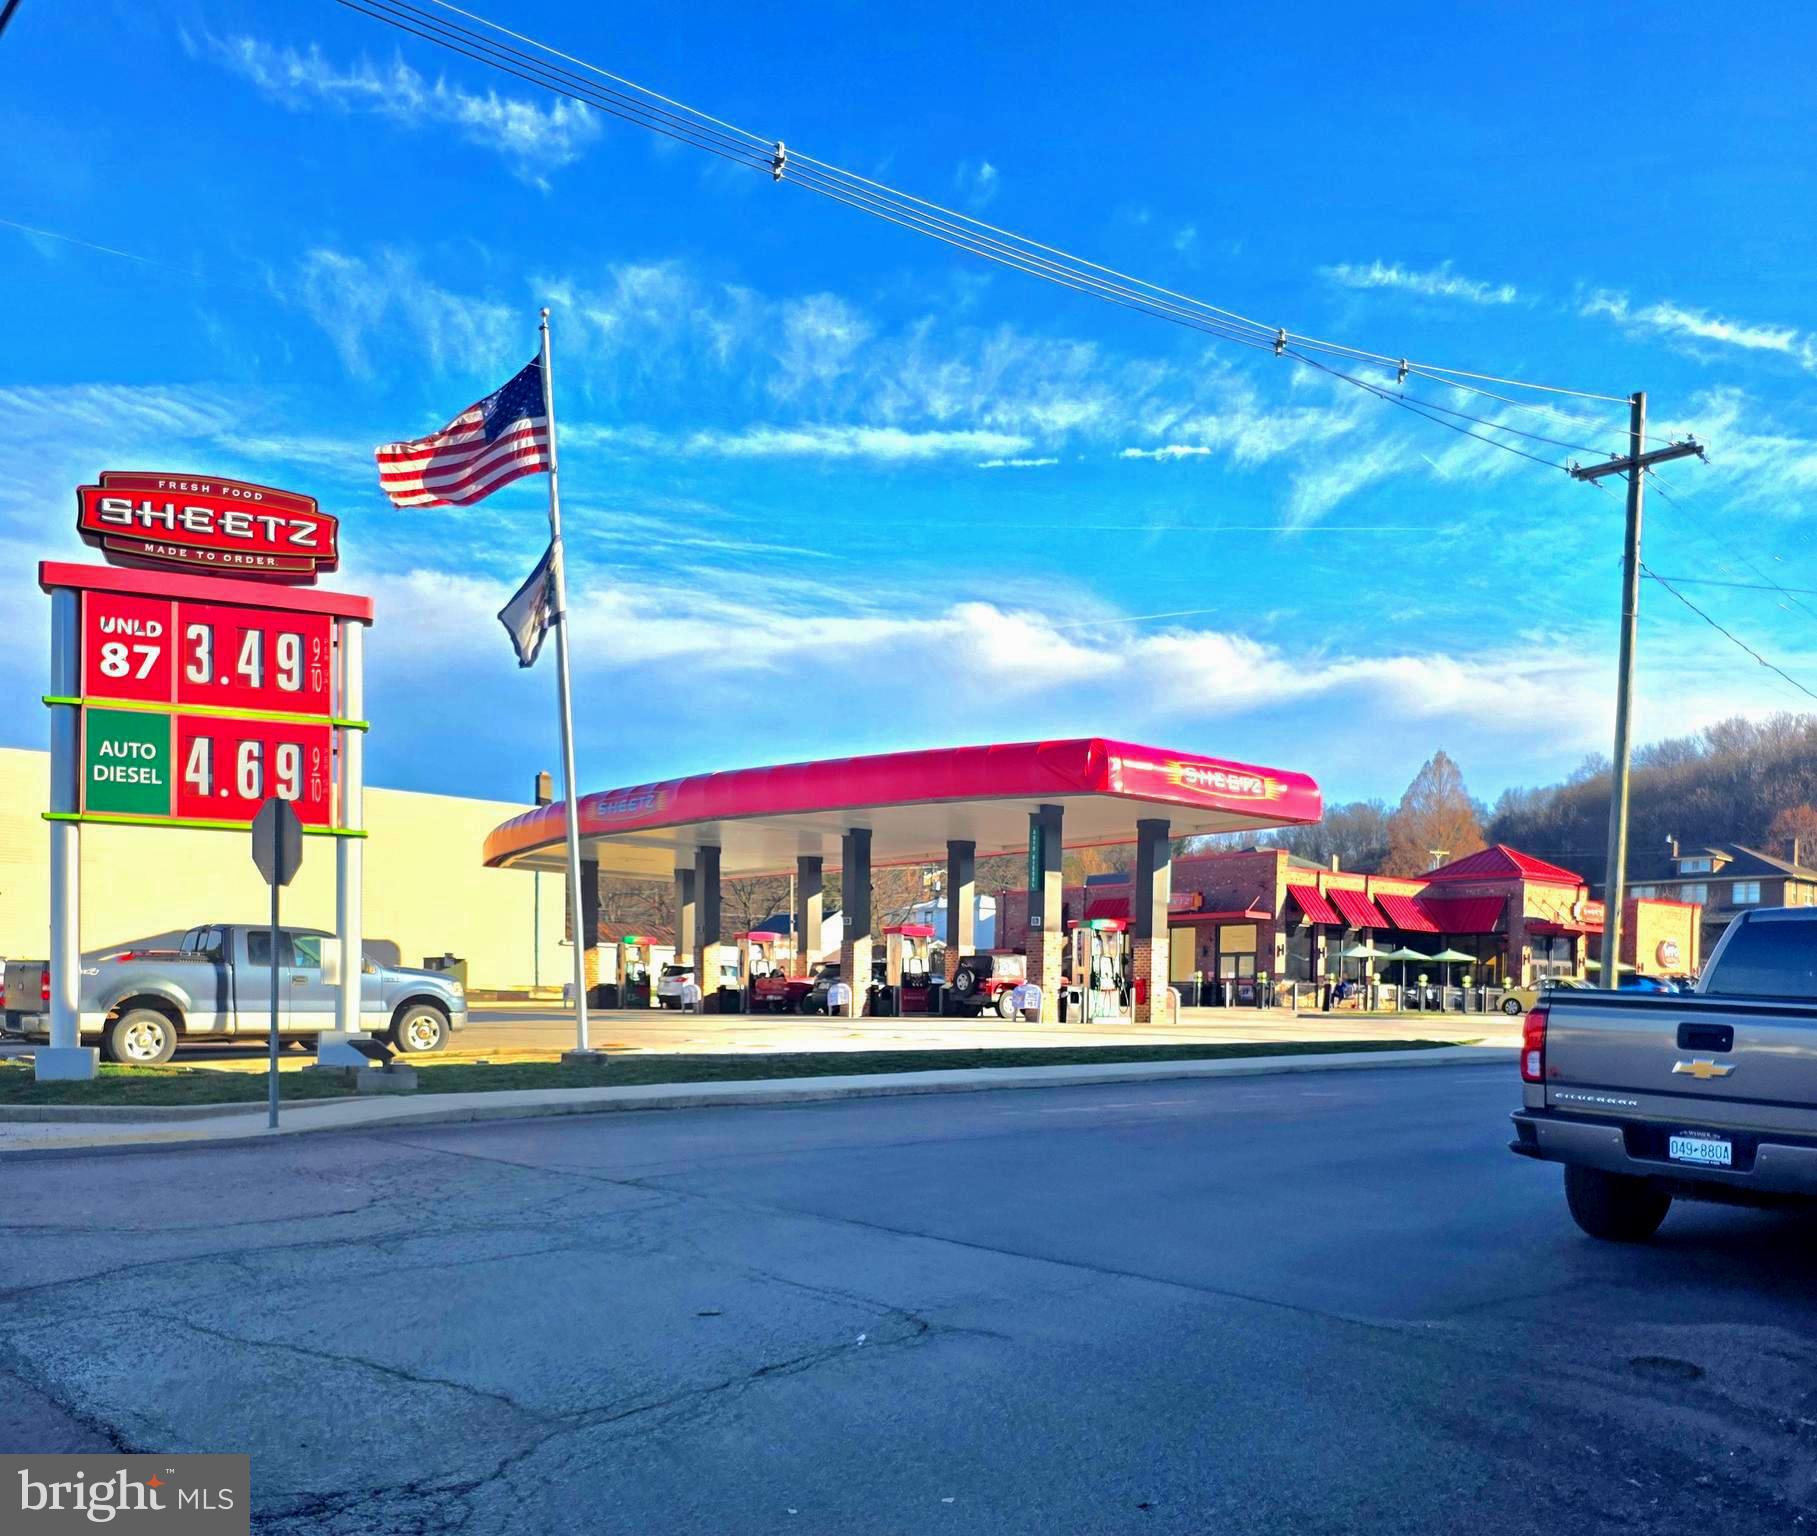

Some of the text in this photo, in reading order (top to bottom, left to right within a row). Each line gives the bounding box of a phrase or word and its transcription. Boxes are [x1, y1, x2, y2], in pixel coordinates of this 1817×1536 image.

[158, 480, 263, 501] FRESH FOOD
[99, 497, 318, 547] SHEETZ
[144, 543, 187, 558] MADE
[196, 551, 215, 561] TO
[100, 615, 163, 638] UNLD
[100, 641, 161, 680] 87
[186, 623, 301, 692] 3.49
[99, 740, 156, 760] AUTO
[93, 764, 162, 785] DIESEL
[185, 737, 301, 801] 4.69
